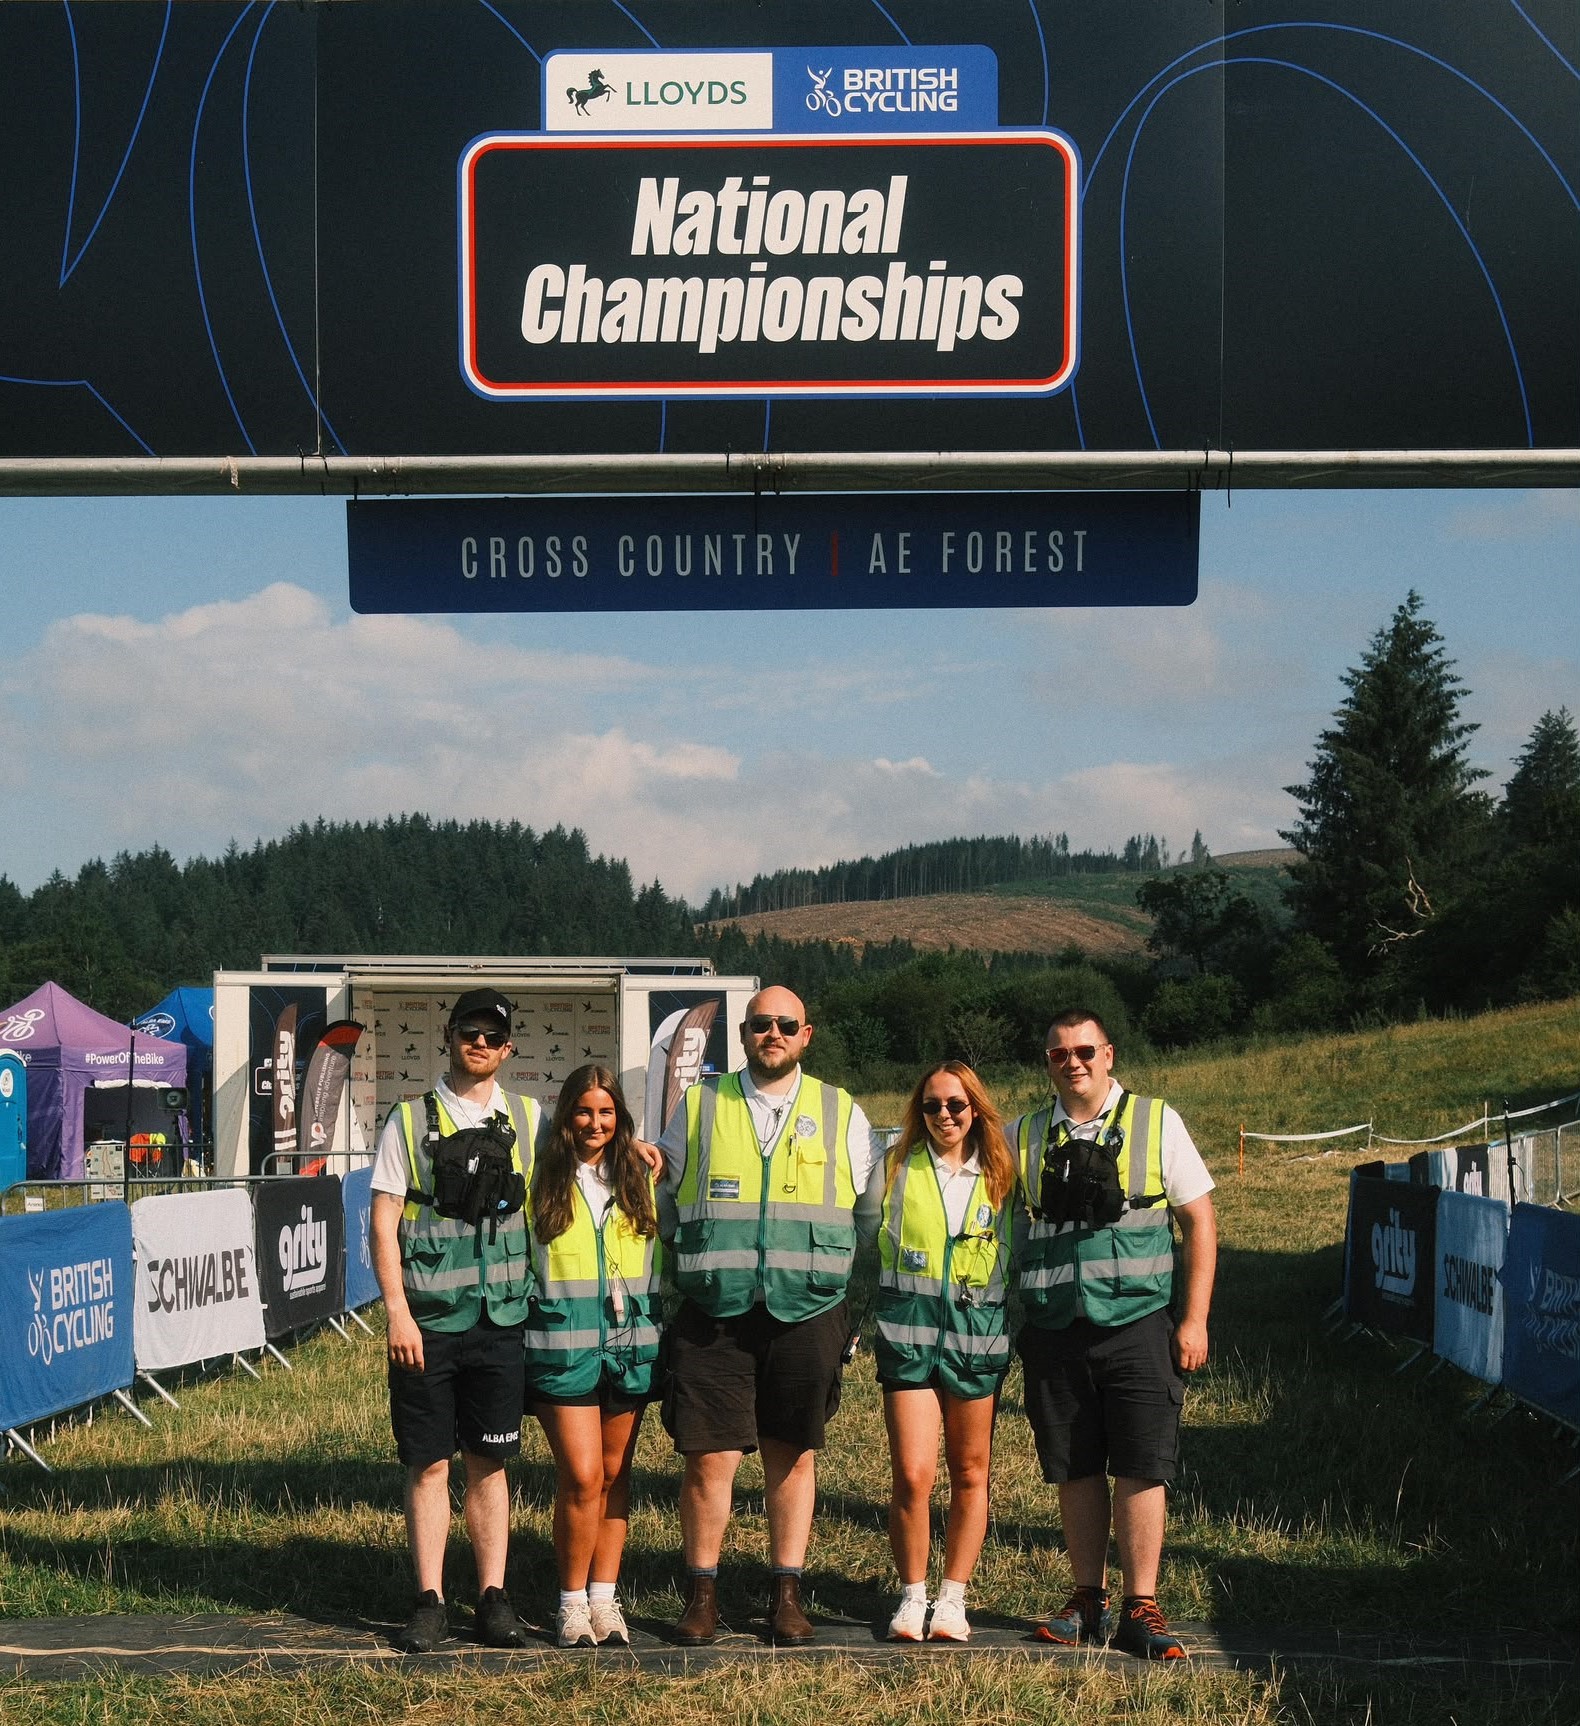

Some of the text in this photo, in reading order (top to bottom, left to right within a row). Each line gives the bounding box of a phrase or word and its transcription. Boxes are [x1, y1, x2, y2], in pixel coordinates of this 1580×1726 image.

[625, 81, 747, 106] LLOYDS
[844, 68, 958, 90] BRITISH
[844, 90, 958, 113] CYCLING
[631, 175, 908, 256] National
[520, 261, 1023, 353] Championships
[461, 530, 1087, 579] CROSS COUNTRY AE FOREST
[674, 1028, 710, 1092] rity
[279, 1204, 327, 1292] grity
[1371, 1207, 1416, 1296] grity
[50, 1258, 113, 1310] BRITISH
[148, 1247, 249, 1314] SCHWALBE
[1443, 1253, 1494, 1317] SCHWALBE
[52, 1301, 114, 1354] CYCLING
[482, 1433, 505, 1443] ALBA
